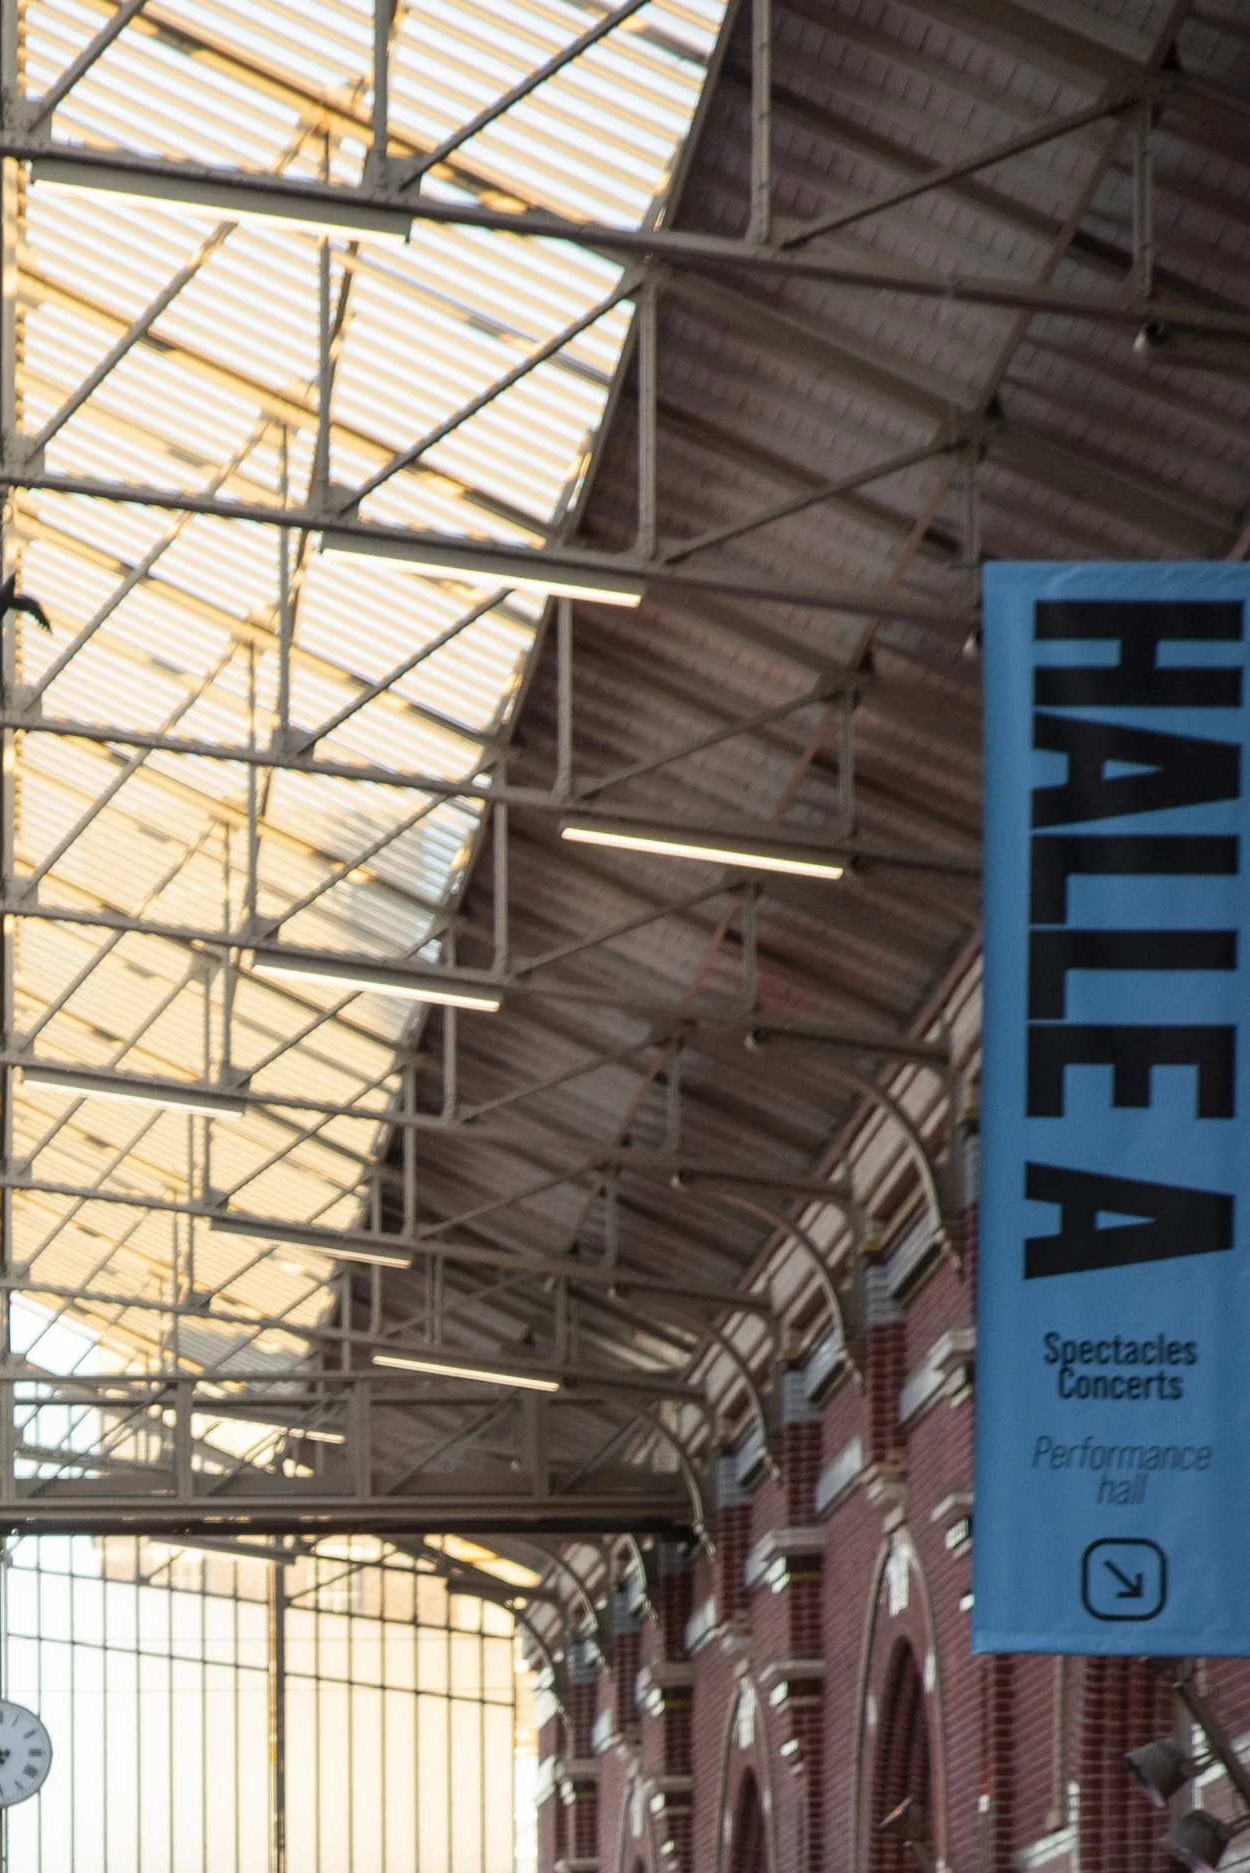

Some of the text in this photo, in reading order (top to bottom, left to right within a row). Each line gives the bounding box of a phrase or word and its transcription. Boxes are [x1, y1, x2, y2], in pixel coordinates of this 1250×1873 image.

[1024, 600, 1244, 1281] HALLE A
[1043, 1331, 1198, 1368] Spectacles
[1058, 1367, 1183, 1400] Concerts
[1031, 1435, 1213, 1471] Performance
[1097, 1472, 1149, 1504] hall
